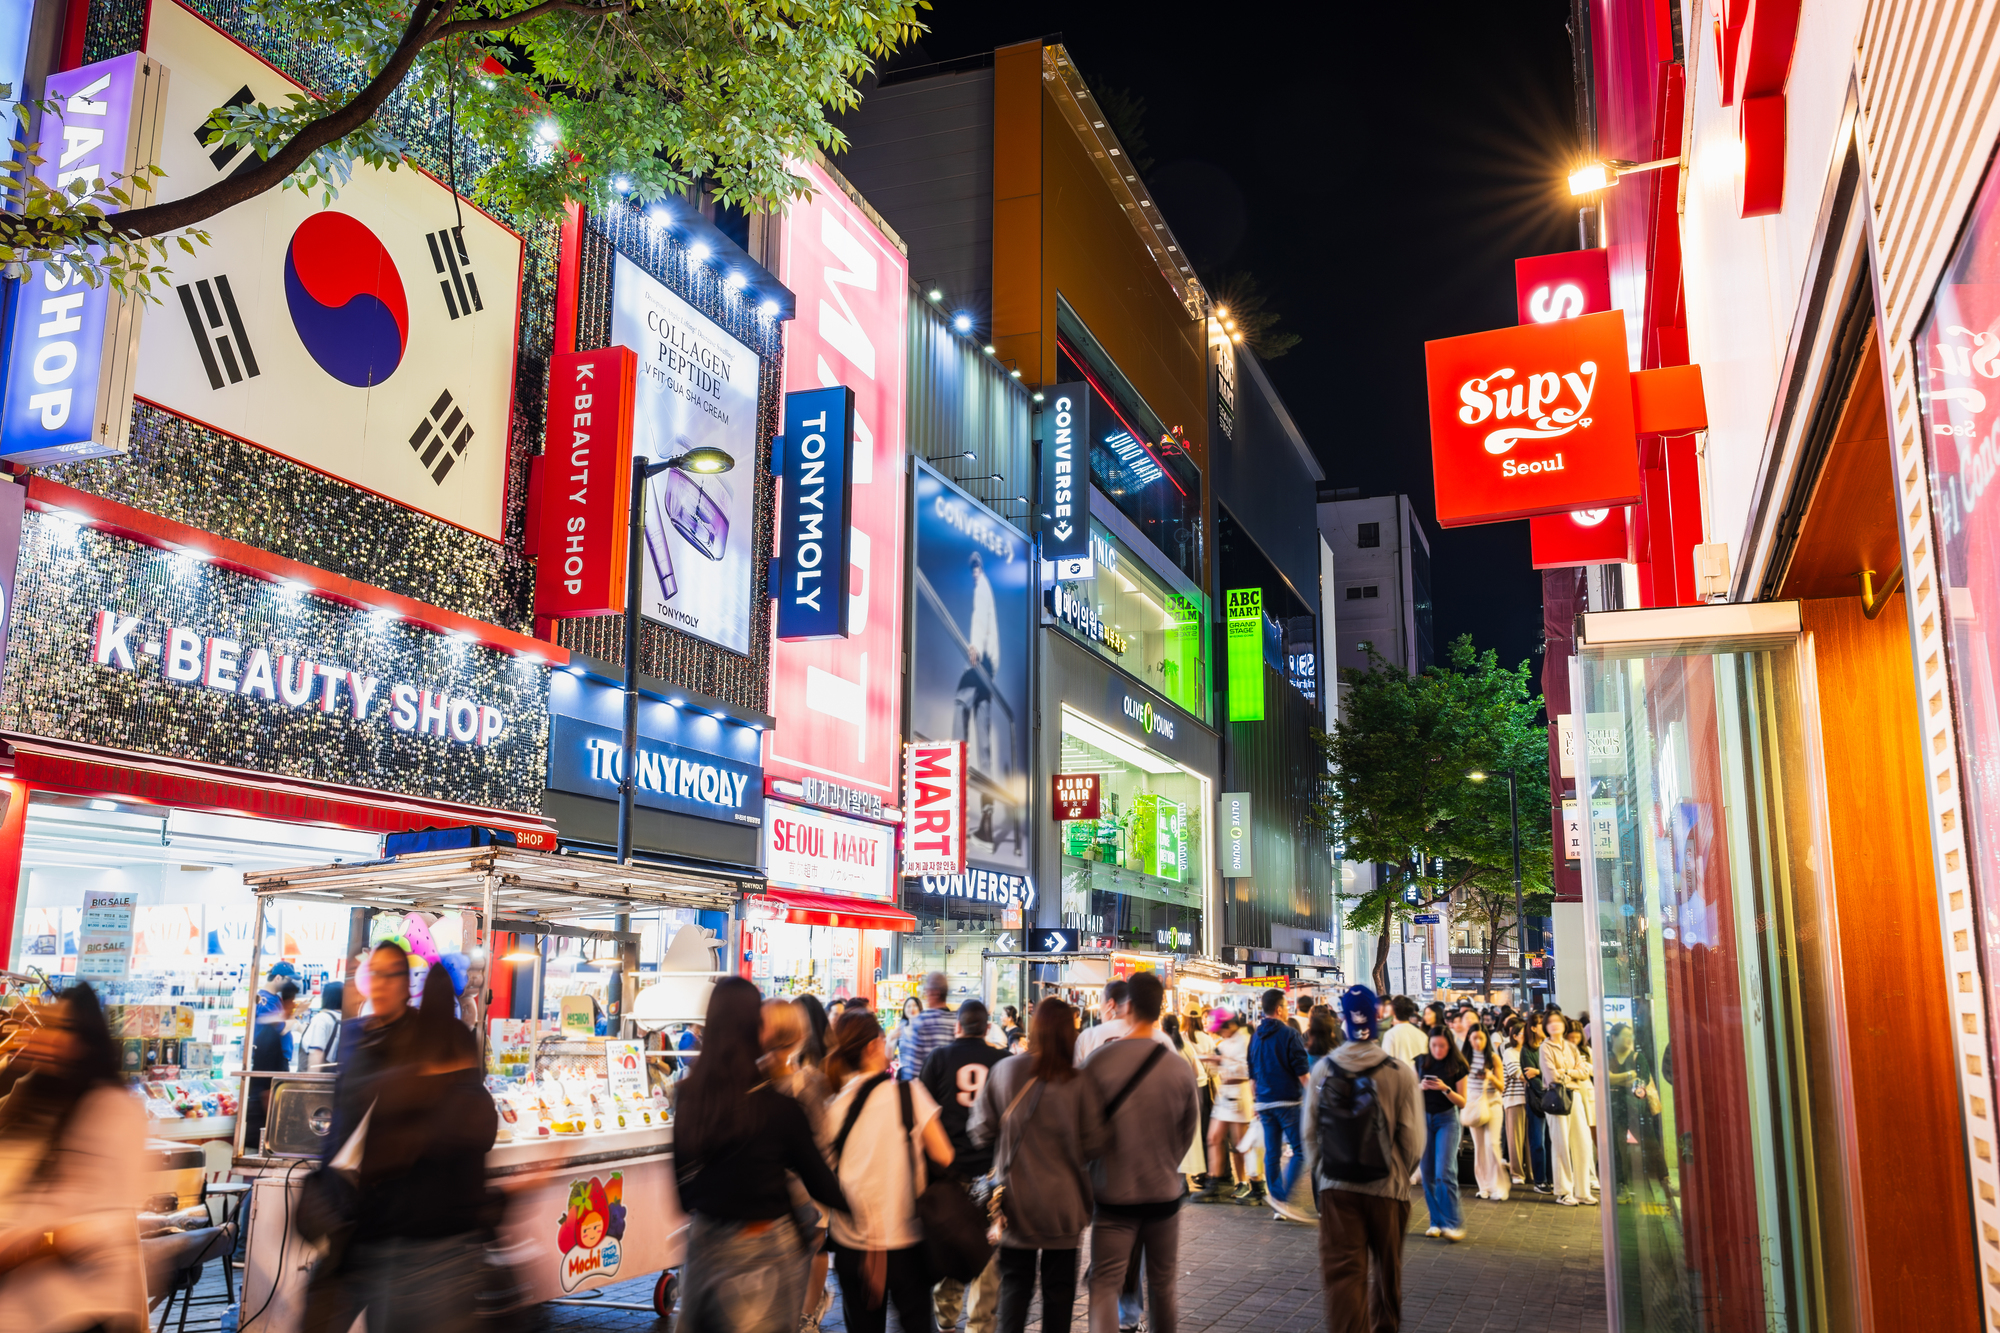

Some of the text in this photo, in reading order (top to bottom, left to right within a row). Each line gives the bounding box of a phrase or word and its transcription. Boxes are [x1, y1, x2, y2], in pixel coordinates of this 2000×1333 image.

[28, 72, 112, 432] VAP SHOP
[647, 310, 731, 383] COLLAGEN
[658, 341, 721, 400] PEPTIDE
[645, 362, 729, 425] V FIT GUA SHA CREAM
[1458, 361, 1597, 440] Supy
[1055, 397, 1072, 518] CONVERSE
[1104, 431, 1163, 485] JUNO HAIR
[1502, 453, 1565, 478] Seoul
[563, 363, 595, 595] K-BEAUTY SHOP
[795, 411, 826, 613] TONYMOLY
[935, 495, 1004, 556] CONVERSE
[1071, 565, 1081, 573] 3F
[1229, 591, 1259, 607] ABC
[1229, 606, 1260, 618] MART
[657, 602, 699, 629] TONYMOLY
[1062, 592, 1098, 641] 메이의원
[1104, 625, 1120, 652] 피부과
[1229, 627, 1254, 635] STAGE
[93, 610, 503, 747] K-BEAUTY SHOP
[1123, 695, 1174, 740] OLIVE YOUNG
[805, 777, 882, 819] 세계과자할인점
[1057, 778, 1093, 790] JUNO
[1060, 789, 1089, 801] HAIR
[914, 748, 952, 856] MART
[1069, 808, 1082, 817] 4F
[517, 832, 543, 845] SHOP
[774, 819, 878, 867] SEOUL MART
[1232, 800, 1241, 870] OLIVE YOUNG
[907, 861, 957, 872] 세계과자할인점
[741, 881, 764, 890] TONYMOLY
[922, 868, 1020, 905] CONVERSE
[92, 897, 130, 907] BIG SALE
[1066, 911, 1104, 933] JUNO HAIR
[87, 942, 125, 952] BIG SALE
[755, 932, 768, 954] IG
[1158, 930, 1191, 946] OLIVE YOUNG
[1424, 964, 1433, 990] ETUDE
[1604, 1004, 1625, 1012] CNP
[956, 1063, 989, 1108] 9
[568, 1248, 601, 1278] Mochi
